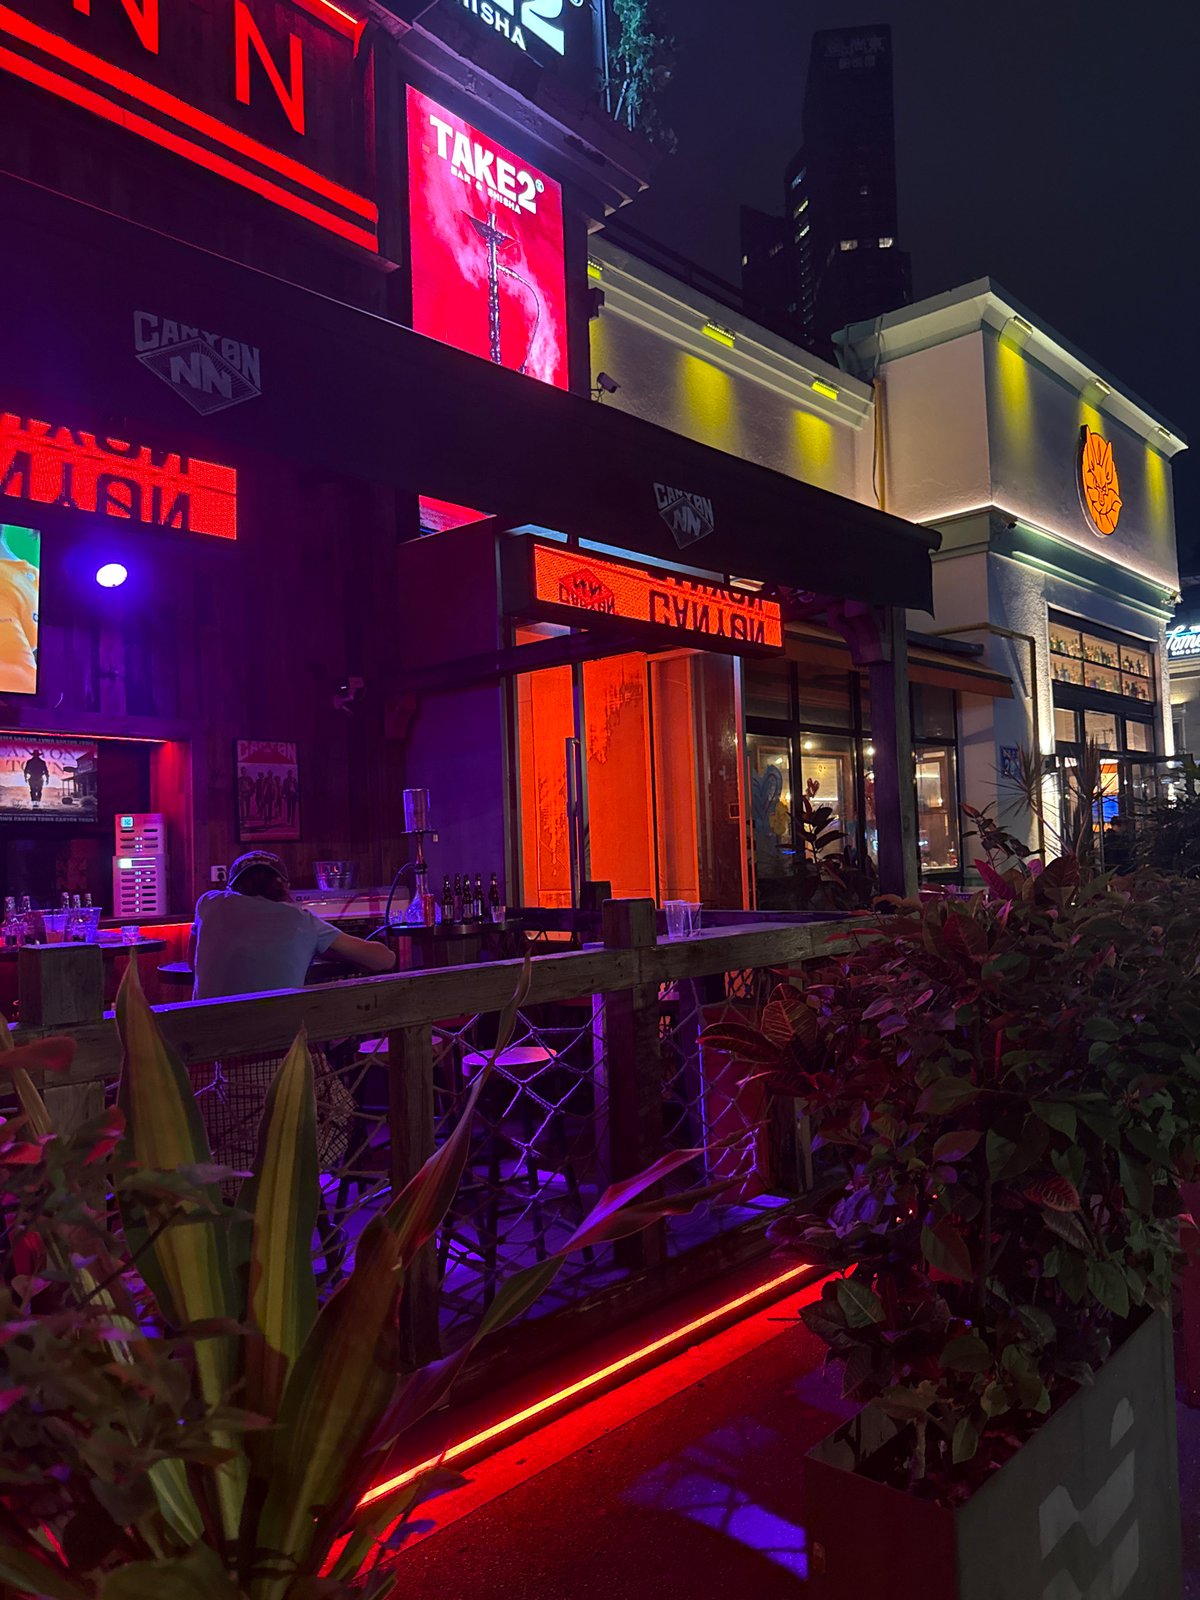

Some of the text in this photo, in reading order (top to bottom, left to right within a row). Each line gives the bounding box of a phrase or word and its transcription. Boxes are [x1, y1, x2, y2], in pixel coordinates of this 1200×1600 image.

[133, 309, 262, 393] CANYON
[169, 351, 233, 400] NN
[653, 482, 715, 531] CANYON
[673, 506, 702, 537] NN
